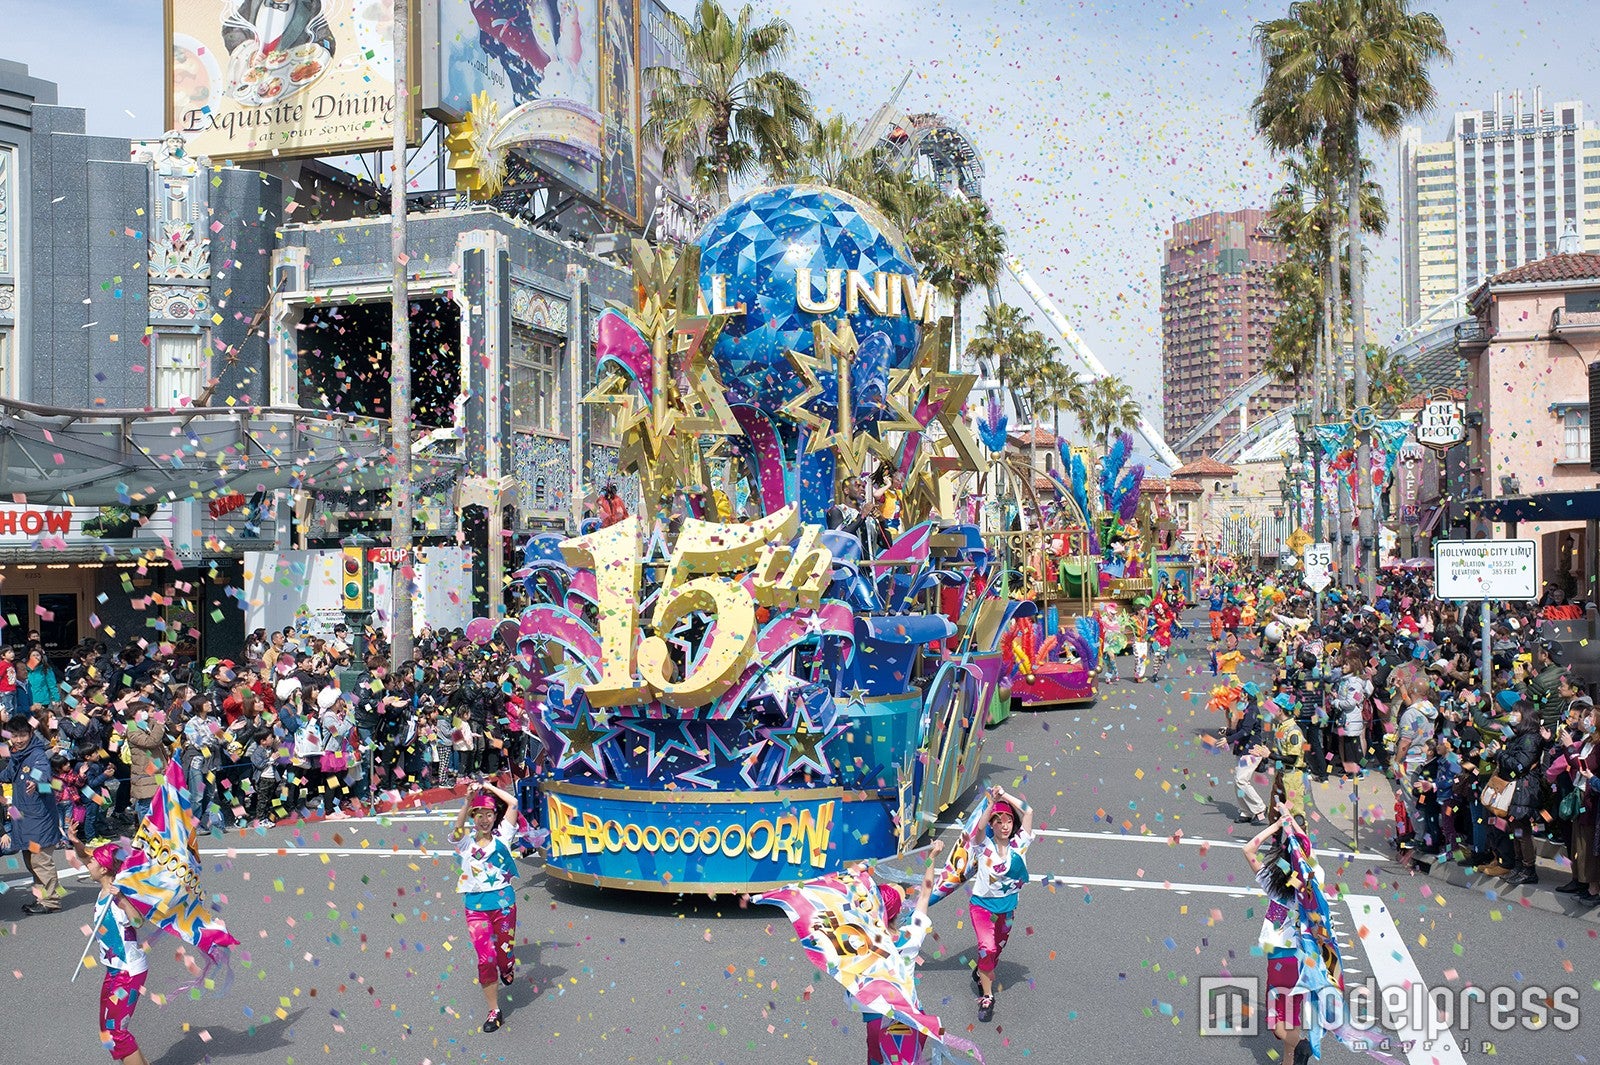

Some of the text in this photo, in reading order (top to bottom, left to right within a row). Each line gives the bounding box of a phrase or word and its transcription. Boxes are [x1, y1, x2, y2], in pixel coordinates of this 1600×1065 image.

[183, 100, 303, 139] Exquisite
[259, 131, 275, 142] at
[279, 128, 317, 145] your
[1429, 405, 1453, 415] ONE
[1430, 416, 1452, 426] DAY
[1422, 426, 1461, 437] PHOTO
[1400, 447, 1423, 463] PINK
[380, 548, 407, 561] STOP
[1440, 546, 1532, 557] HOLLYWOOD CITY LIMIT
[1308, 553, 1330, 566] 35
[1451, 560, 1485, 568] POPULATION
